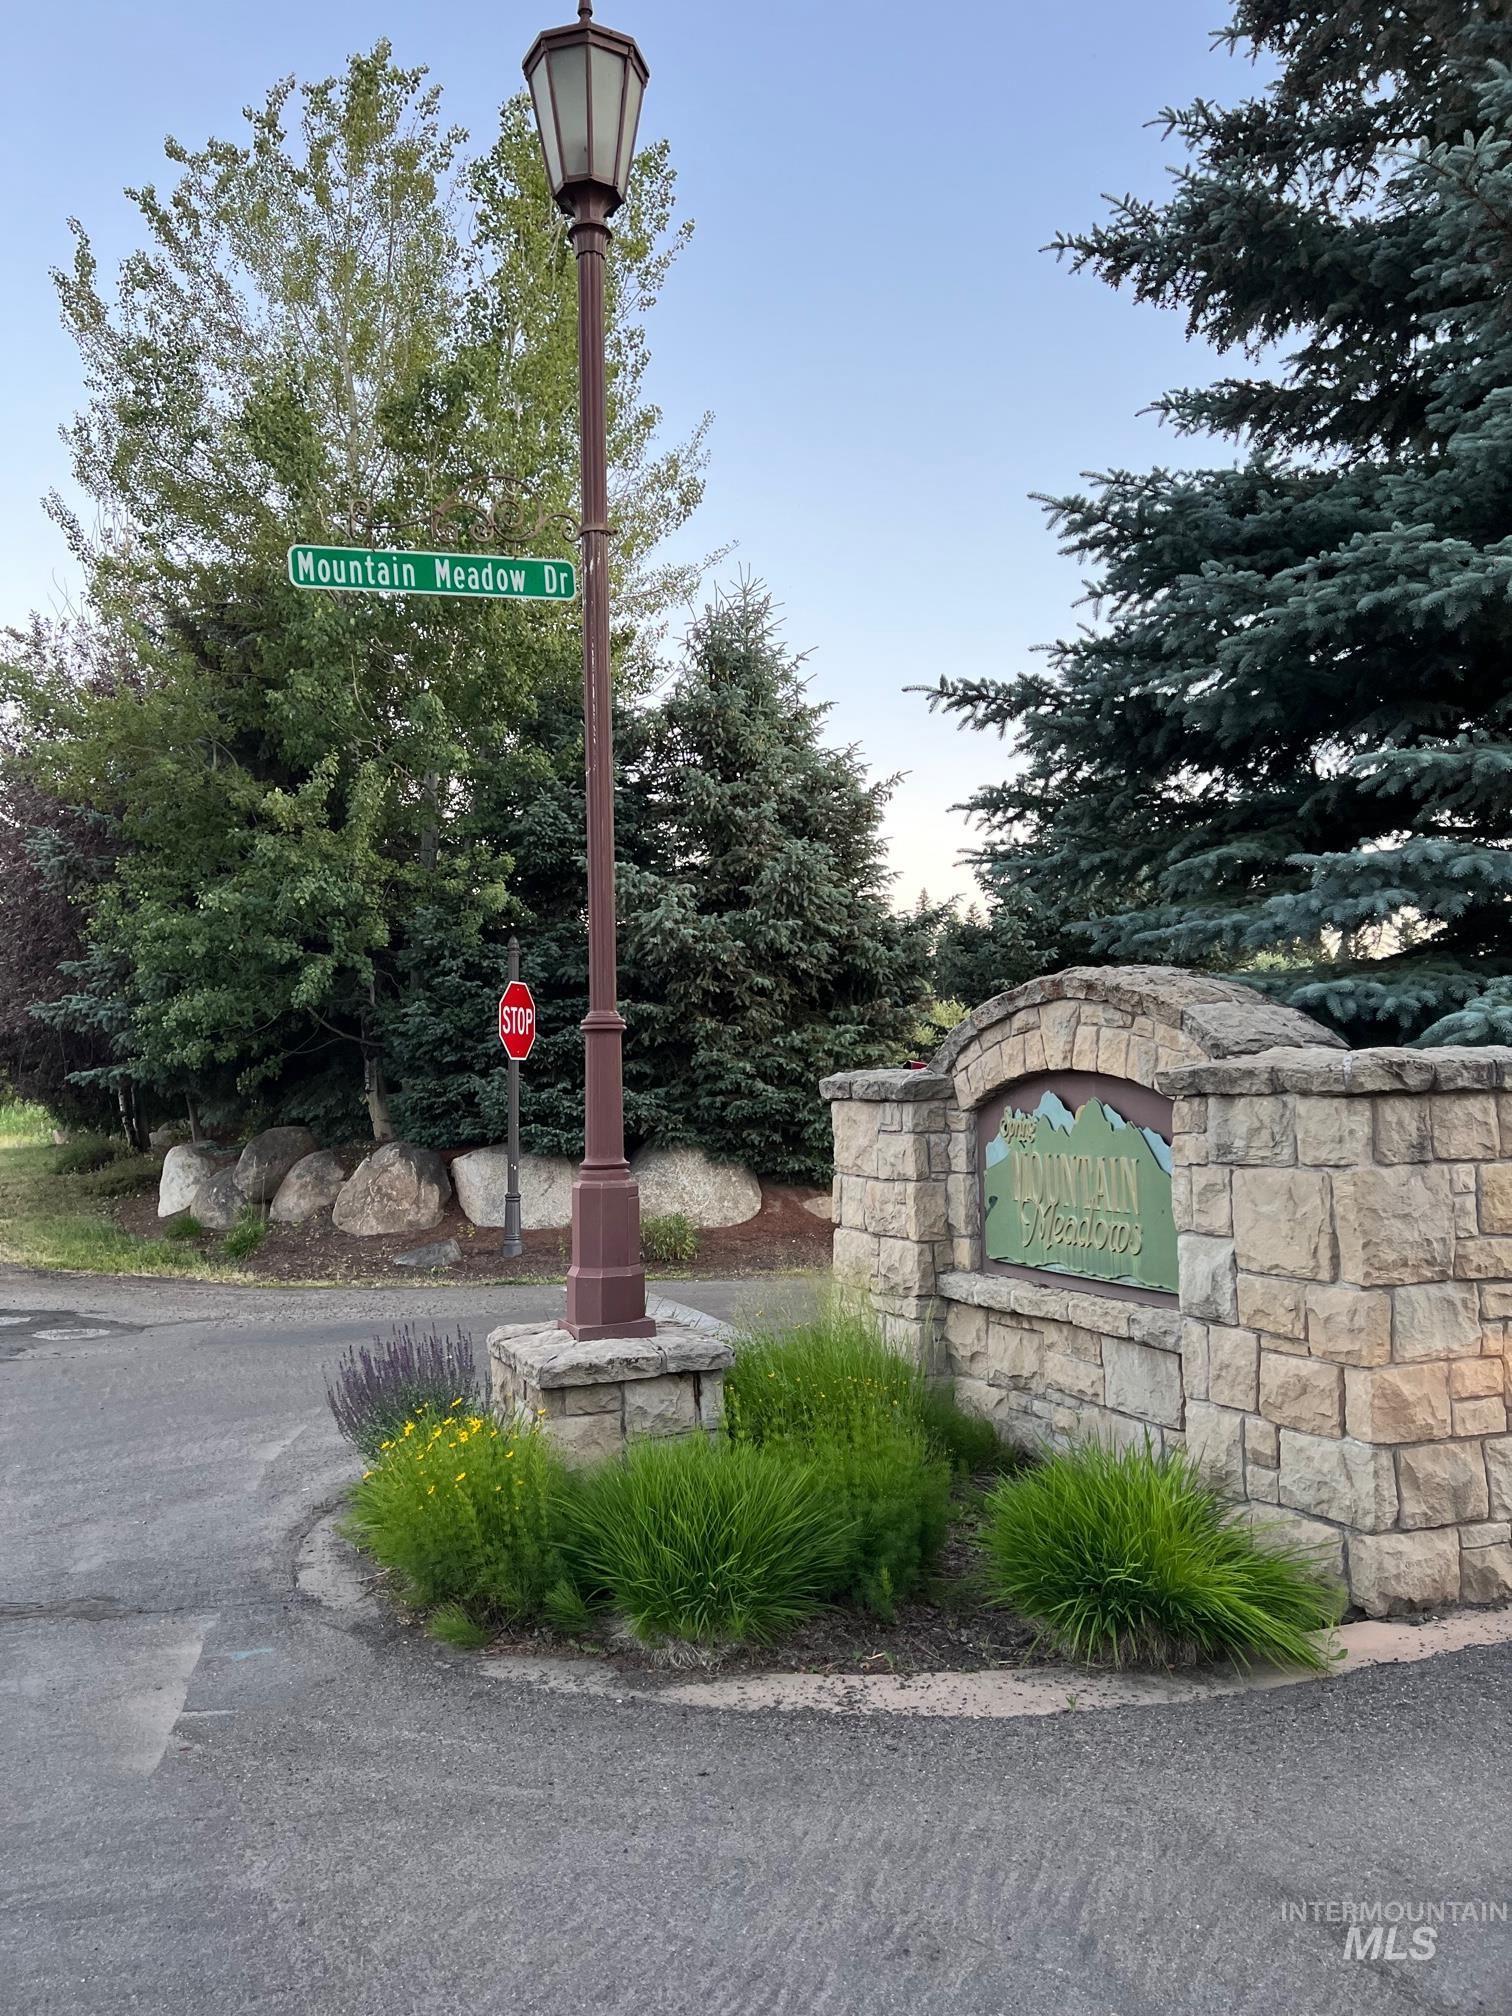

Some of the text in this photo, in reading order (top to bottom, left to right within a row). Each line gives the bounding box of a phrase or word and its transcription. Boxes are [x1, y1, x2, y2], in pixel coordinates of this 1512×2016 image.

[297, 551, 569, 595] Mountain Meadow Dr
[502, 1005, 533, 1036] STOP
[1001, 1105, 1038, 1144] Spring
[1020, 1198, 1142, 1255] Meadows
